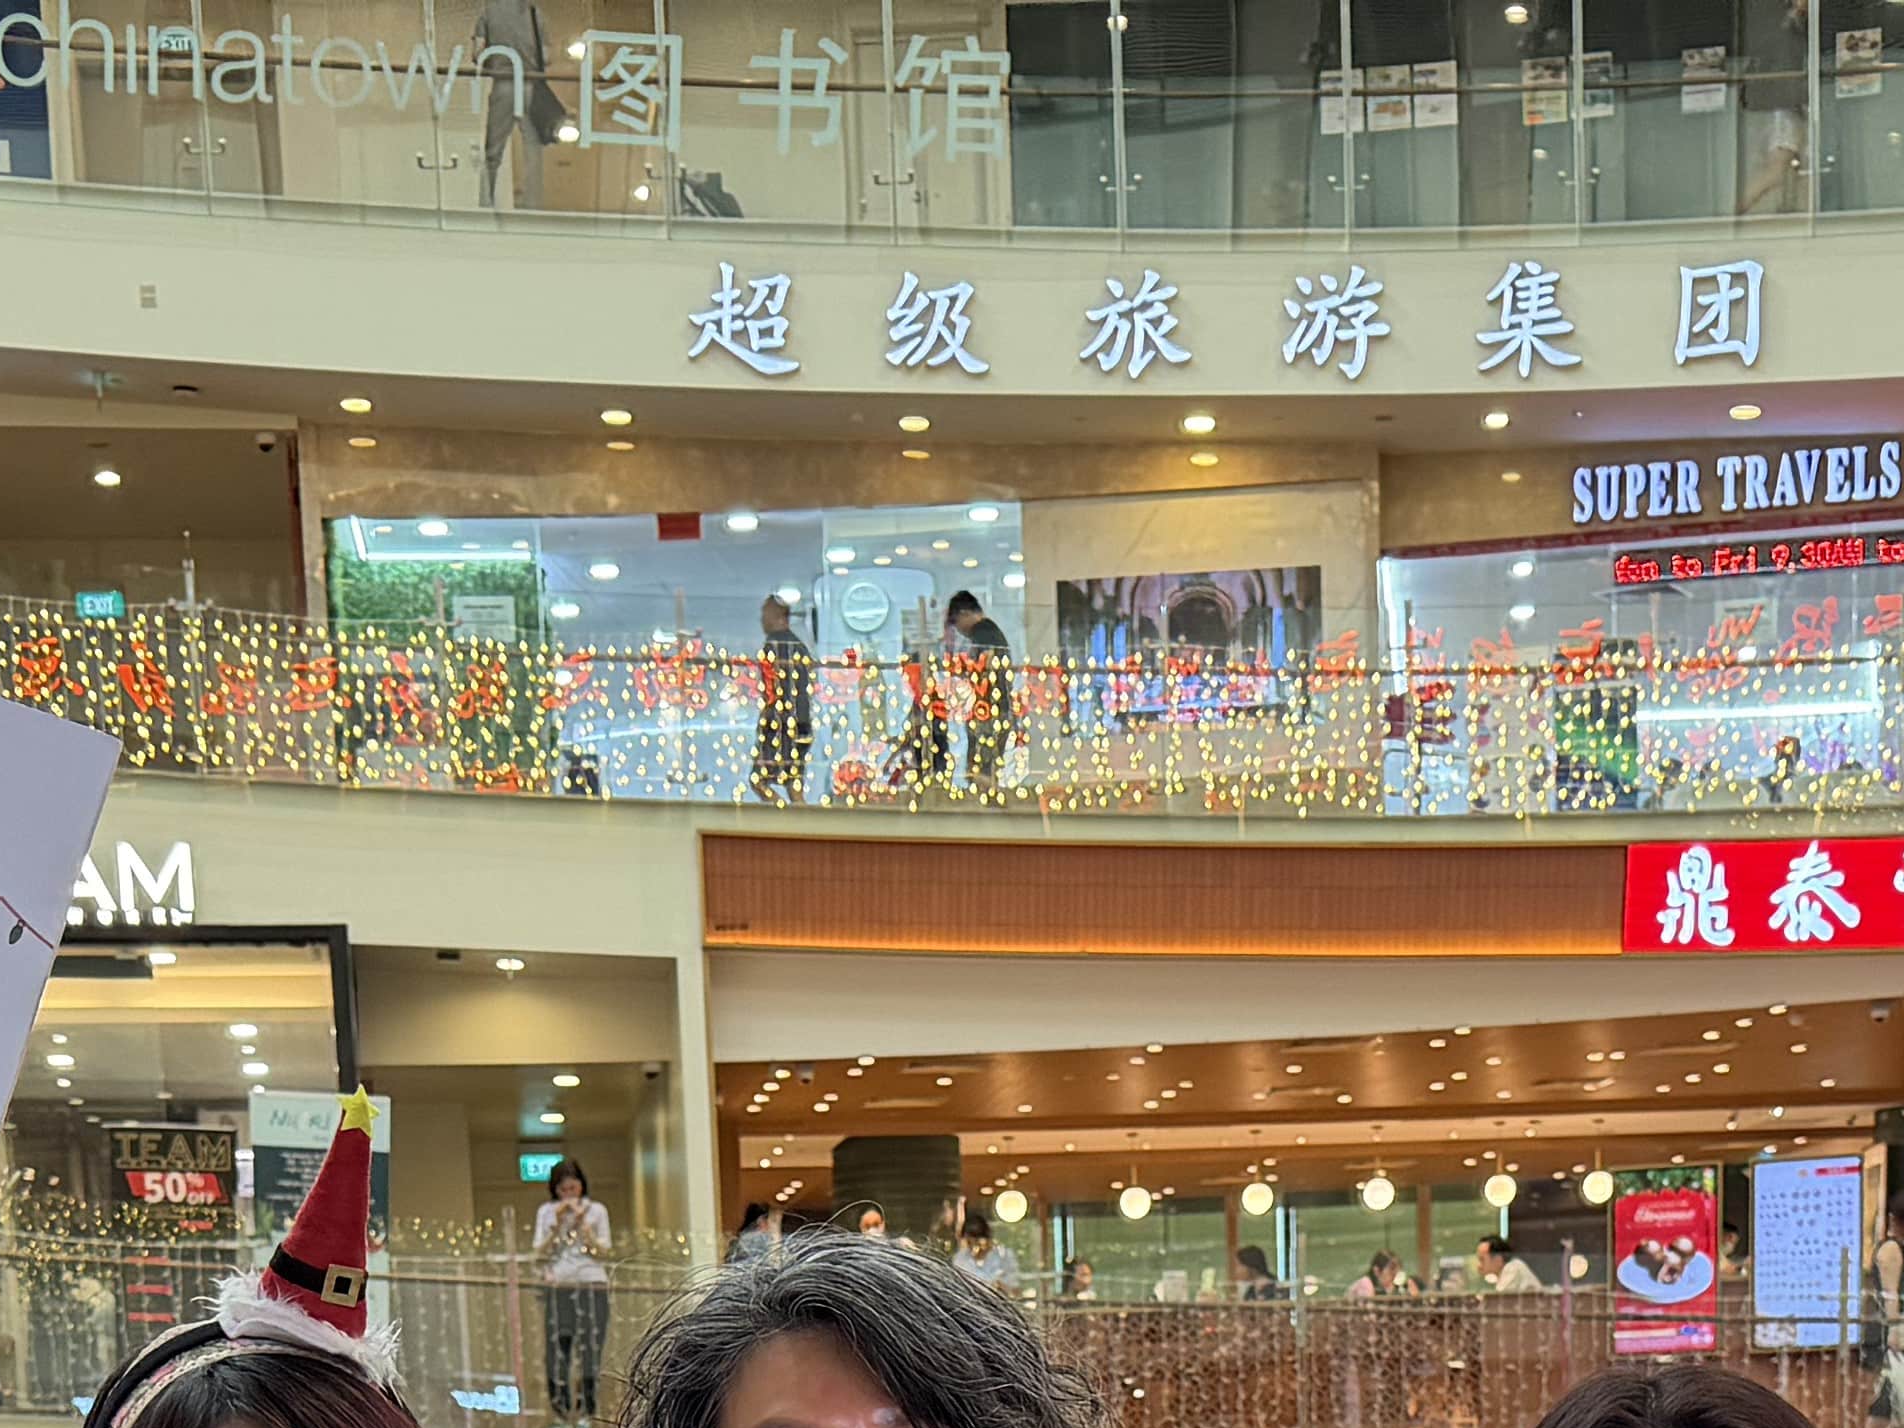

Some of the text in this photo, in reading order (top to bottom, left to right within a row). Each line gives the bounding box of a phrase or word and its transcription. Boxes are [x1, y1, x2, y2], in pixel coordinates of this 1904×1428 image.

[578, 28, 1011, 163] 图书馆
[687, 260, 1766, 382] 超级旅游集团
[1572, 441, 1903, 524] SUPER TRAVELS
[1712, 544, 1758, 576] Fri
